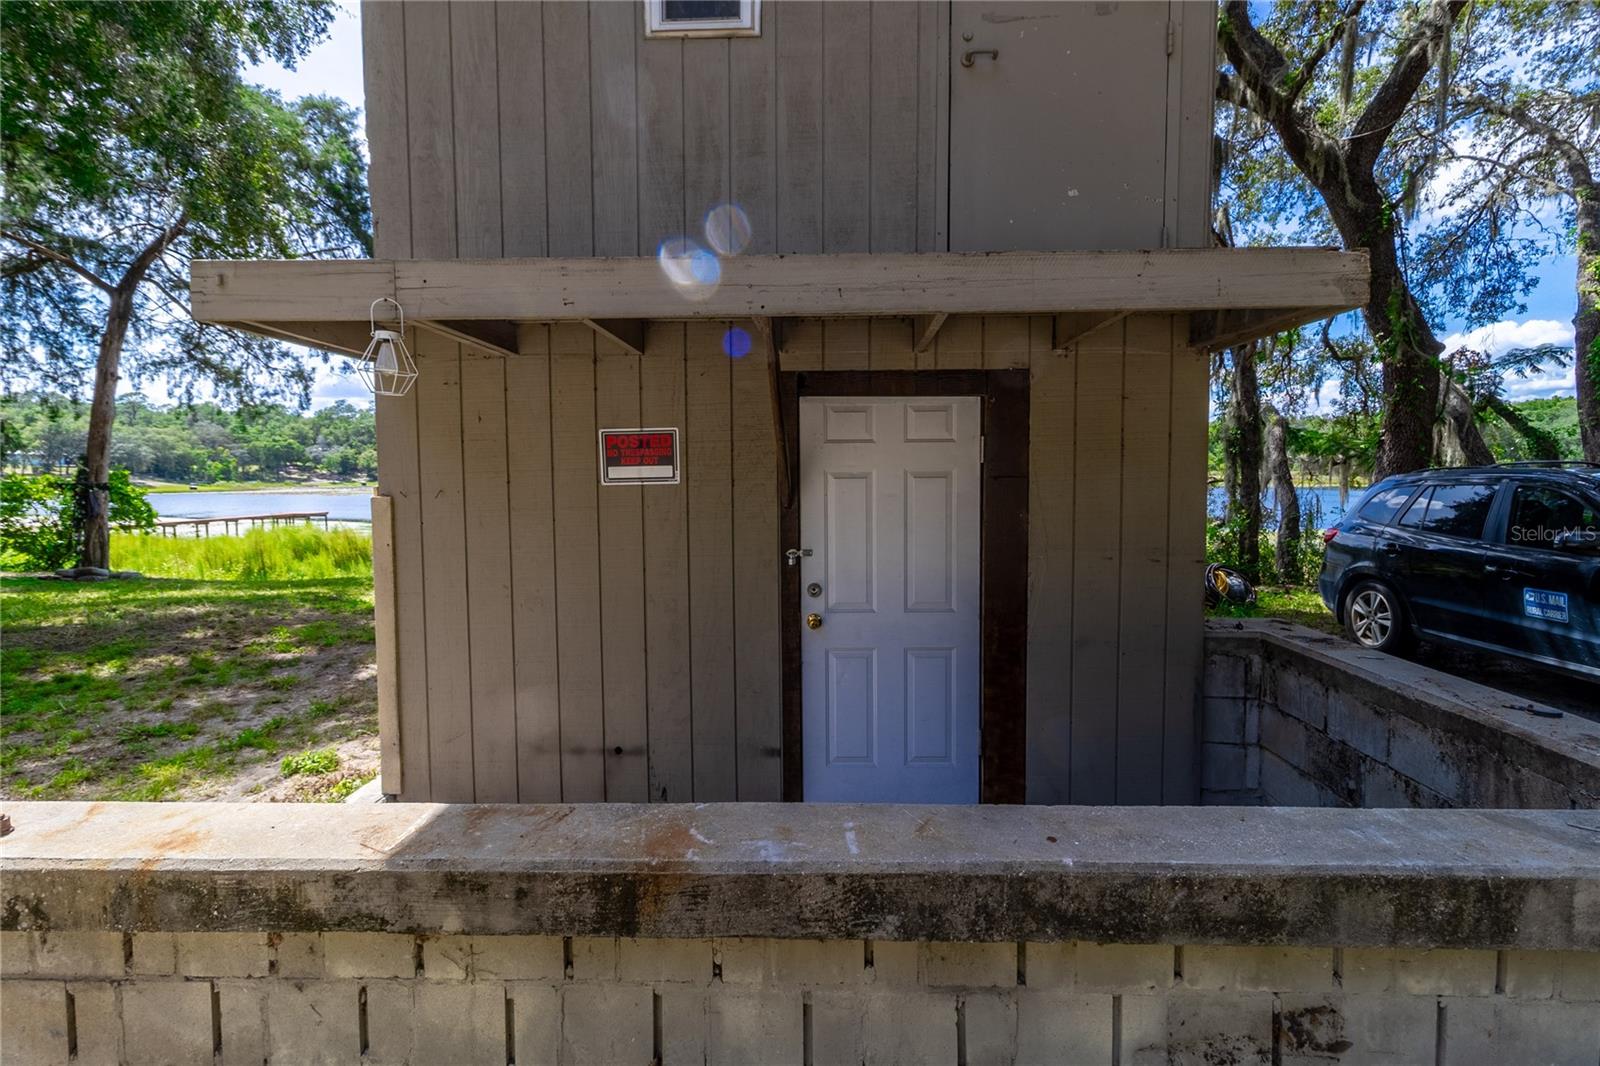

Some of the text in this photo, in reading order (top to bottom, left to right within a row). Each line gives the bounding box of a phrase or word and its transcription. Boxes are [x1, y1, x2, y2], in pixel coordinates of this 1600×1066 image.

[606, 434, 672, 449] POSTED
[607, 447, 672, 457] NO TRESPASSING
[621, 456, 658, 465] KEEP OUT
[1548, 594, 1566, 607] MAIL
